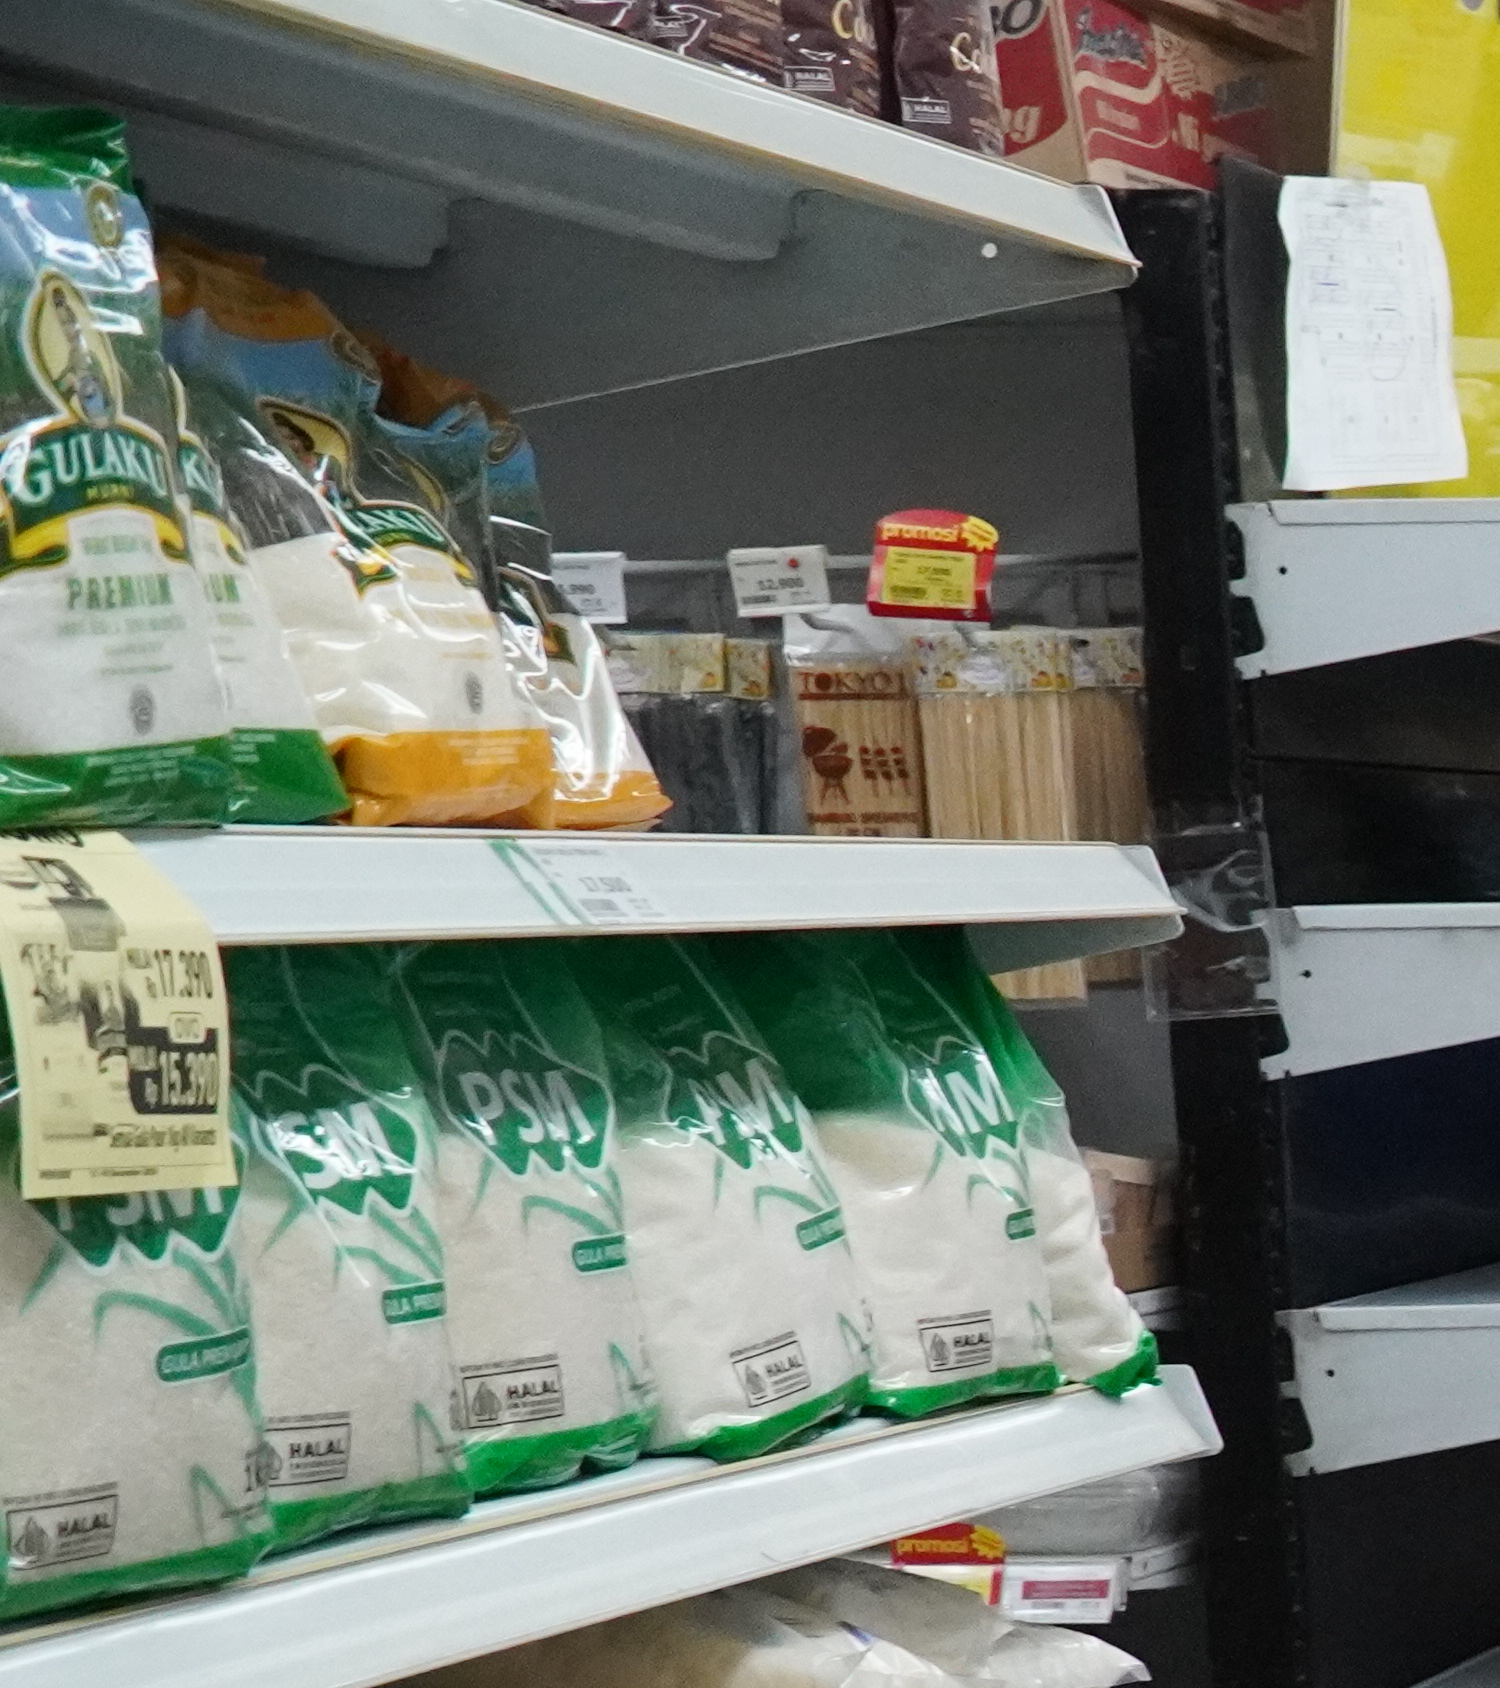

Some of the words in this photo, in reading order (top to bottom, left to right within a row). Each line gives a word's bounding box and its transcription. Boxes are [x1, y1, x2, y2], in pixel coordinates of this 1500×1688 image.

[22, 430, 166, 503] GULAKU
[67, 572, 173, 609] PREMIUM
[460, 1069, 595, 1145] PSM
[953, 1331, 992, 1347] HALAL
[764, 1355, 803, 1379] HALAL
[507, 1379, 563, 1401] HALAL
[289, 1441, 345, 1459] HALAL
[57, 1513, 112, 1537] HALAL
